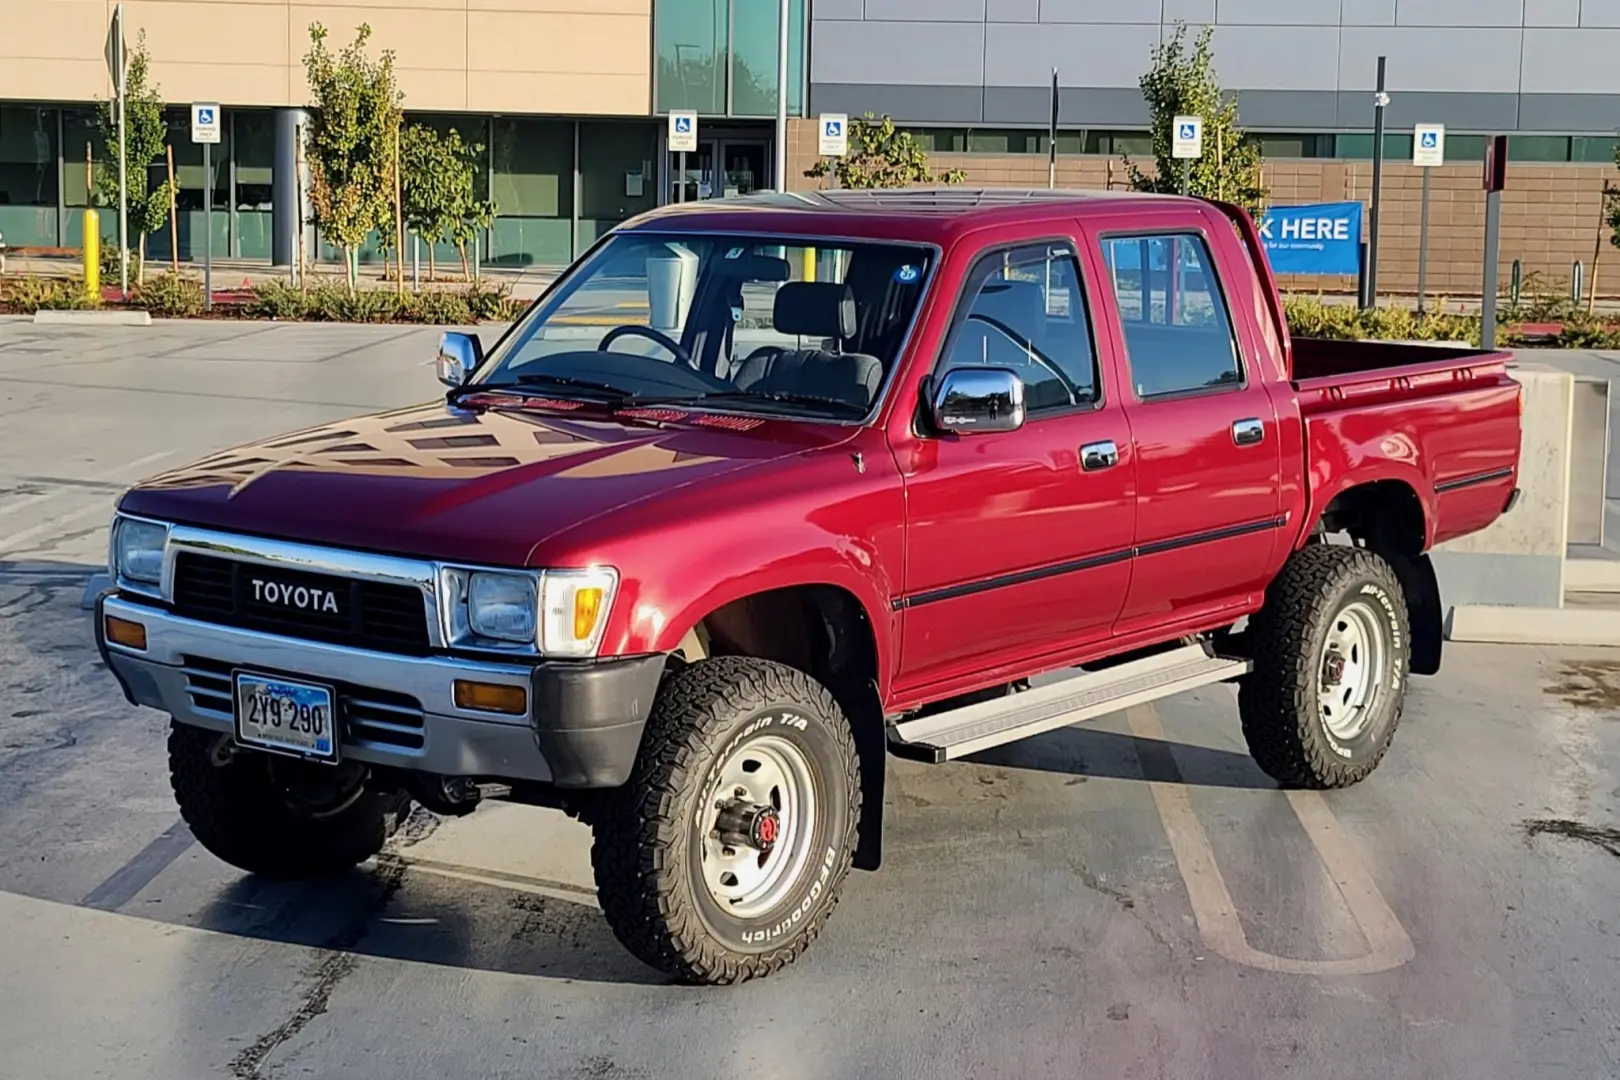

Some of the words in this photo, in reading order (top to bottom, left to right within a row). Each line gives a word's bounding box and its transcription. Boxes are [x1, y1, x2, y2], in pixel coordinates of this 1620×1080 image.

[1281, 217, 1349, 240] HERE
[252, 579, 338, 613] TOYOTA
[1391, 658, 1402, 690] T/A
[780, 713, 808, 731] T/A
[741, 846, 836, 944] BFGoodrich
